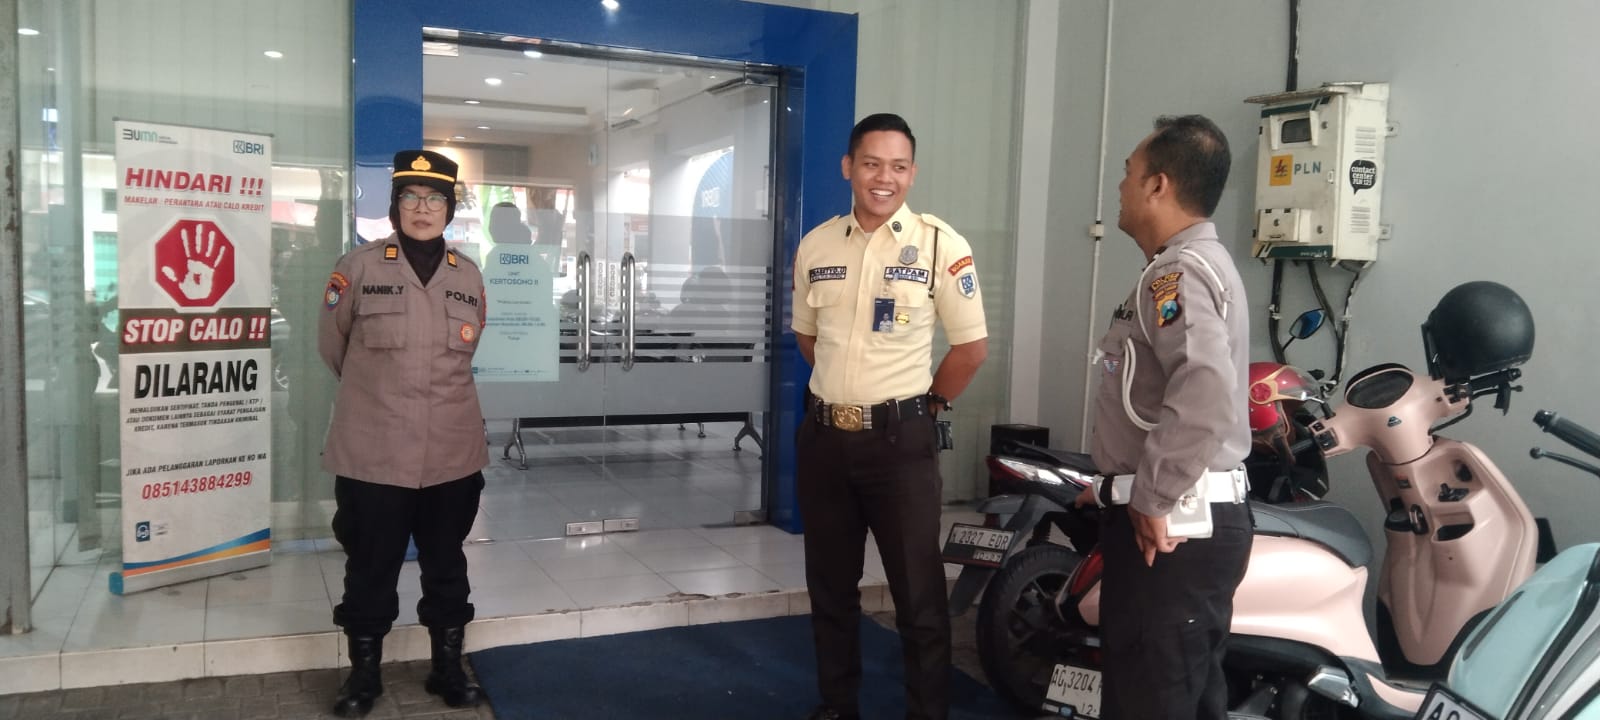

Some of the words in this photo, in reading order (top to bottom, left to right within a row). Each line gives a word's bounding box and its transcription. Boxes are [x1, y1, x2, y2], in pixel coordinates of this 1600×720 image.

[245, 142, 264, 155] BRI
[1294, 161, 1321, 176] PLN
[125, 167, 232, 194] HINDARI
[239, 176, 264, 196] !!!
[164, 198, 203, 208] PERANTARA
[223, 201, 240, 210] CALO
[241, 203, 265, 212] KREDIT
[511, 254, 529, 265] BRI
[888, 267, 927, 278] SATPAM
[445, 290, 478, 307] POLRI
[124, 317, 184, 344] STOP
[189, 317, 244, 342] CALO
[249, 317, 267, 339] !!
[134, 358, 258, 399] DILARANG
[126, 467, 141, 477] JIKA
[142, 466, 156, 474] ADA
[158, 460, 203, 472] PELANGGARAN
[204, 456, 237, 466] LAPORKAN
[247, 454, 255, 462] NO
[142, 470, 252, 500] 085143884299
[959, 530, 985, 546] 2327
[1051, 668, 1067, 687] AG
[1067, 671, 1096, 692] 3204
